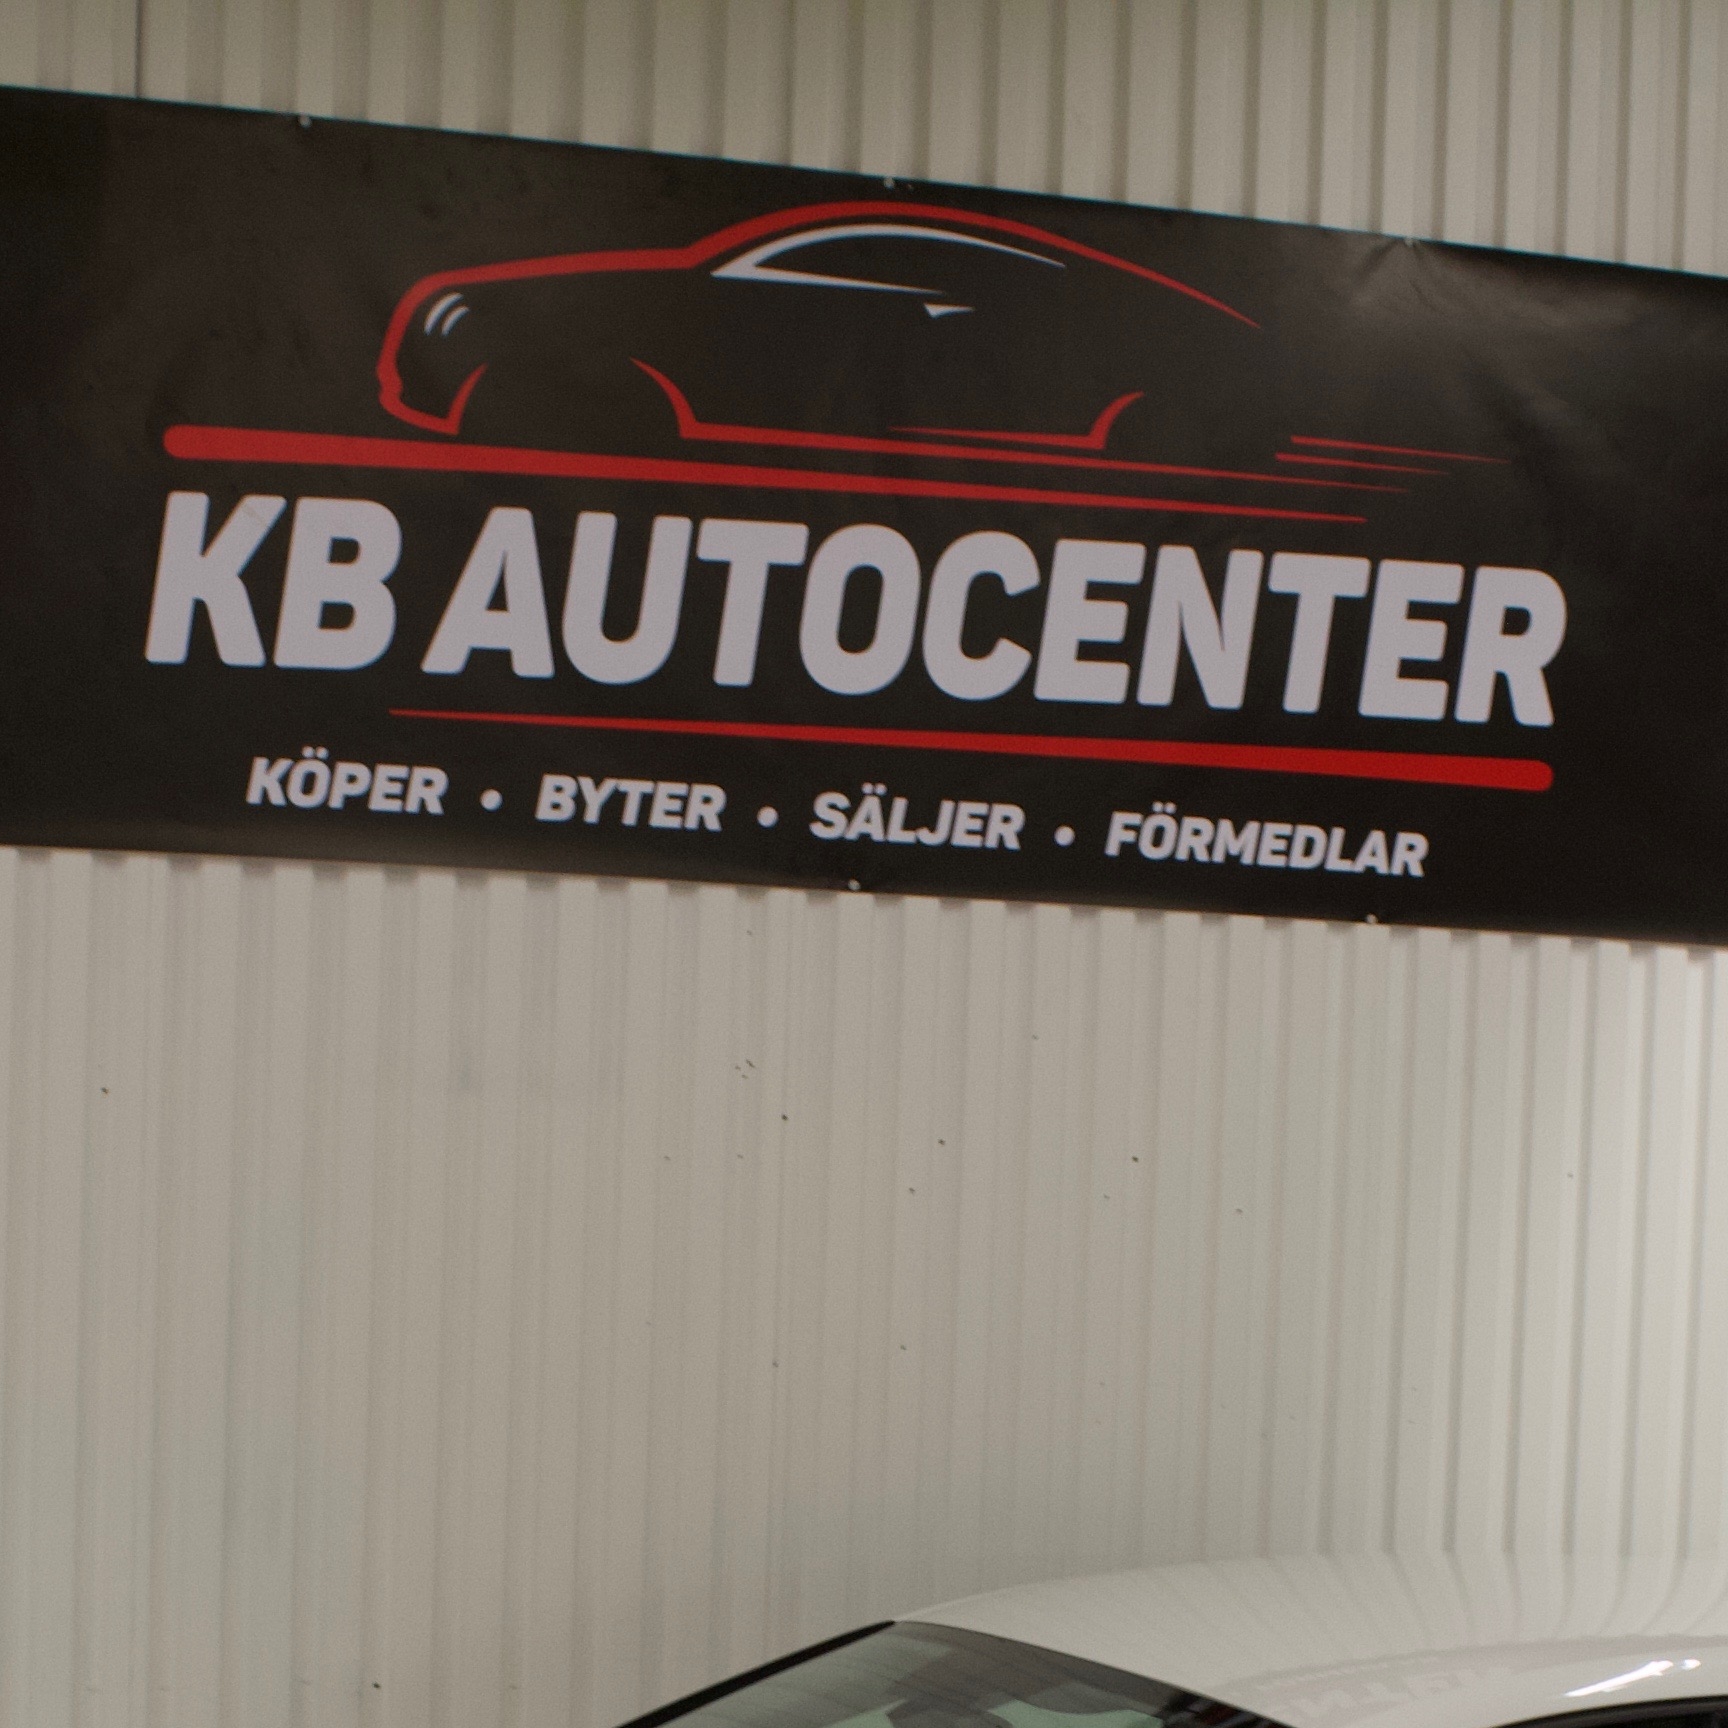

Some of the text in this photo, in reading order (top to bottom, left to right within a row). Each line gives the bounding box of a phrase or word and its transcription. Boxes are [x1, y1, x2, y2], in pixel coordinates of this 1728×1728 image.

[144, 490, 1568, 728] KB AUTOCENTER
[245, 745, 1430, 879] KÖPER BYTER SÄLJER FÖRMEDLAR
